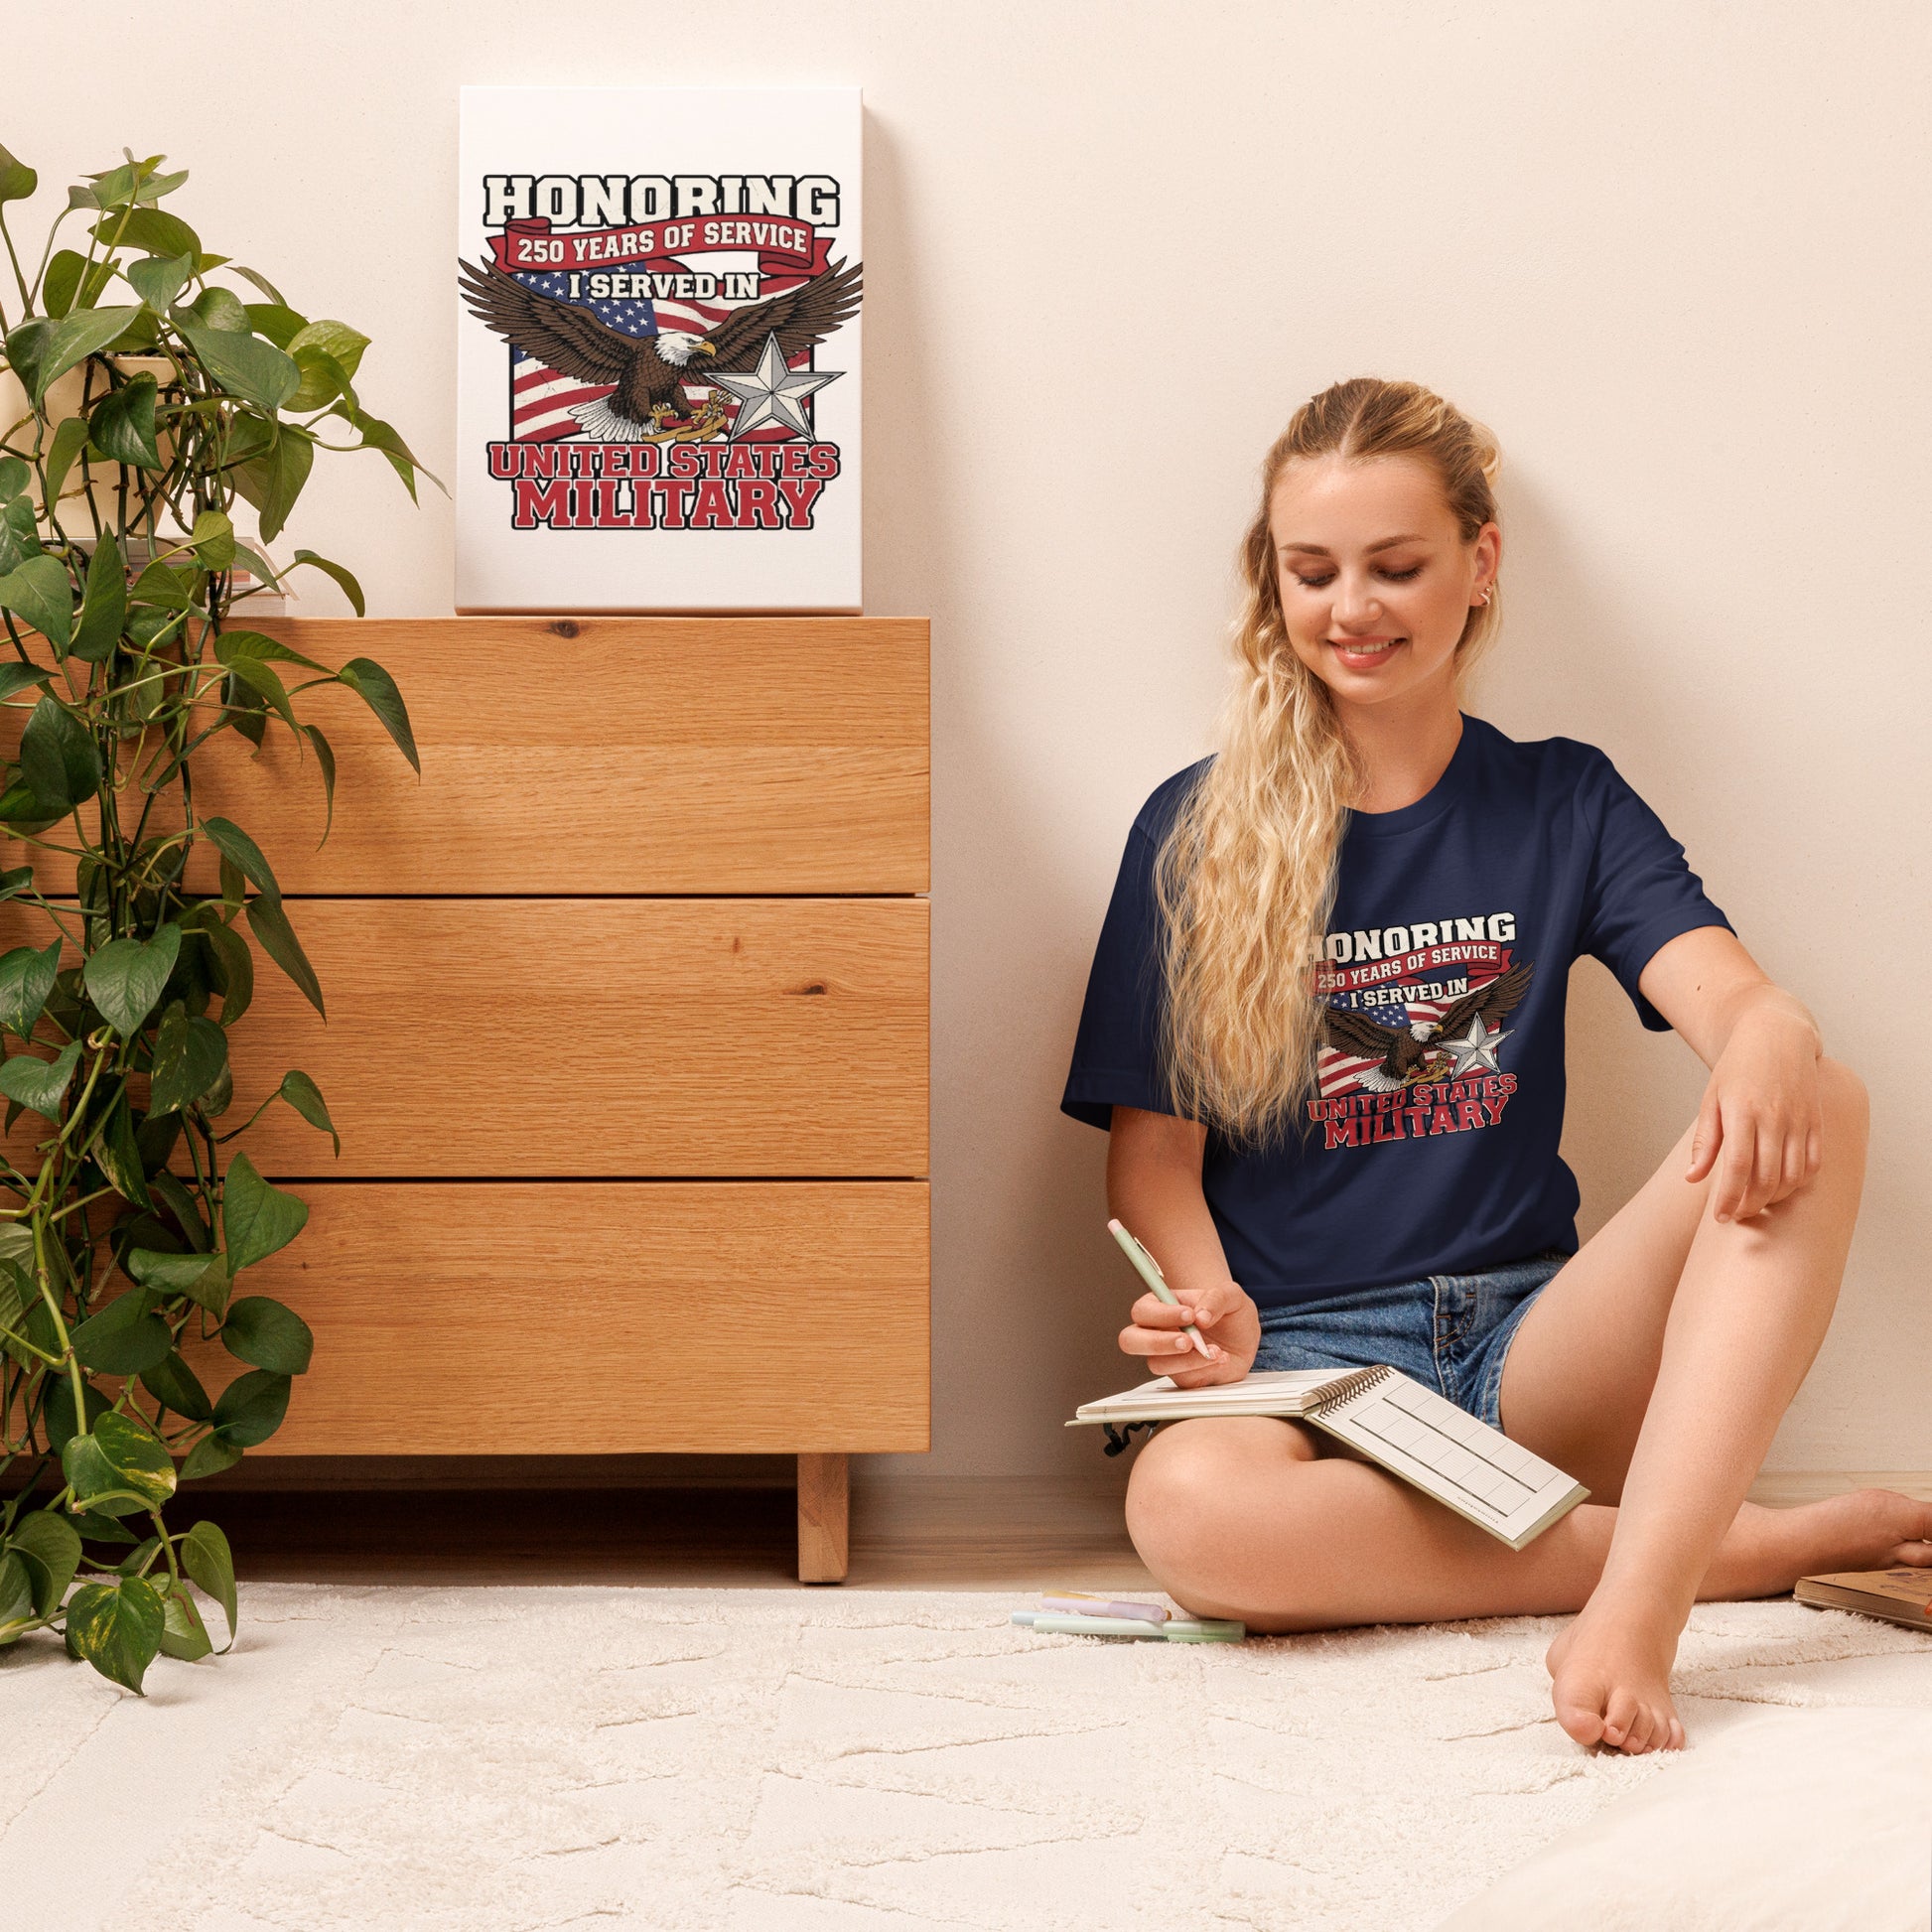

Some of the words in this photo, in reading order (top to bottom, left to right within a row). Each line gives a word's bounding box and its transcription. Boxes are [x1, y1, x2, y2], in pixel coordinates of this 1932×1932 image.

[483, 175, 840, 226] HONORING
[517, 239, 564, 262] 250
[572, 230, 655, 261] YEARS
[663, 224, 695, 249] OF
[704, 220, 808, 254] SERVICE
[569, 273, 582, 299] I
[590, 273, 718, 300] SERVED
[718, 273, 760, 300] IN
[486, 442, 660, 479] UNITED
[668, 443, 841, 480] STATES
[512, 479, 825, 529] MILITARY
[1317, 973, 1345, 990] 250
[1350, 961, 1402, 985] YEARS
[1407, 954, 1427, 971] OF
[1431, 945, 1498, 965] SERVICE
[1349, 991, 1359, 1010] I
[1363, 981, 1444, 1008] SERVED
[1447, 977, 1468, 996] IN
[1307, 1088, 1408, 1121] UNITED
[1413, 1072, 1518, 1107] STATES
[1323, 1095, 1509, 1150] MILITARY
